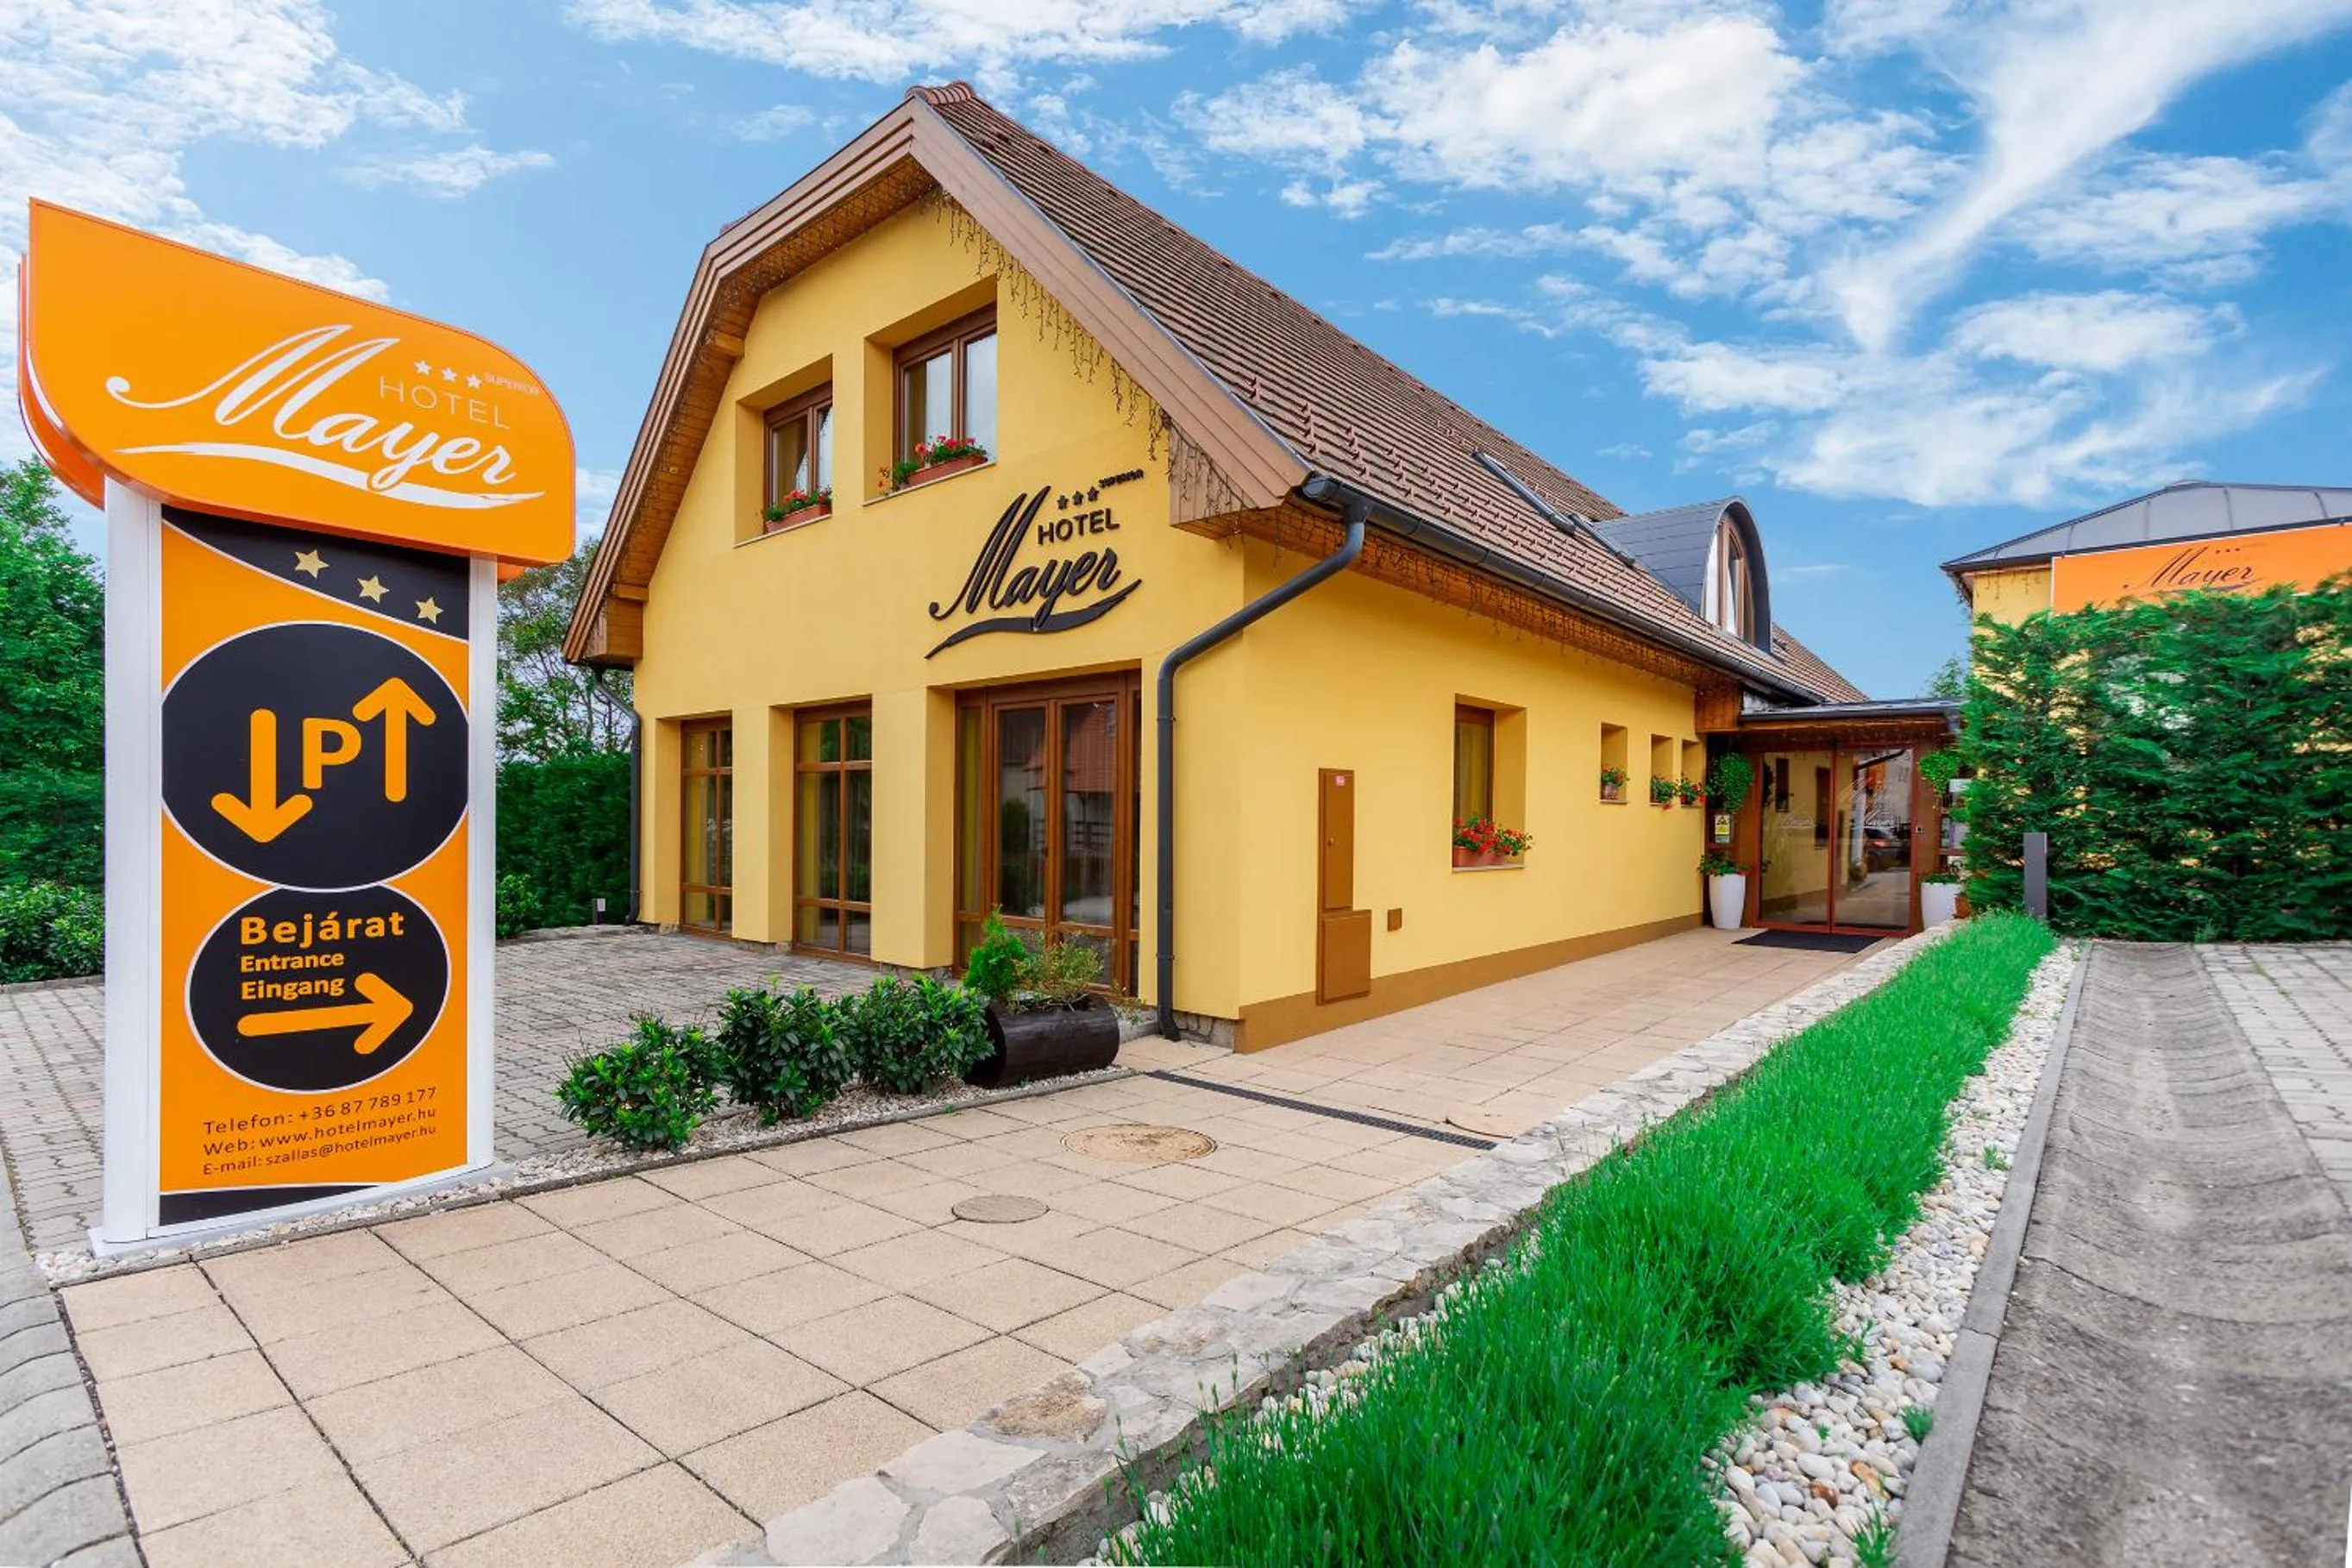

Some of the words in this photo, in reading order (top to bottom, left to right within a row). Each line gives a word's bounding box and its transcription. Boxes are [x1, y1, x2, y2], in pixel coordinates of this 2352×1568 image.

[105, 323, 517, 491] Mayer
[379, 375, 511, 430] HOTEL
[1037, 507, 1120, 546] HOTEL
[928, 485, 1122, 630] Mayer
[2123, 546, 2254, 589] Mayer
[302, 717, 362, 790] P
[240, 911, 405, 949] Bejárat
[240, 951, 345, 973] Entrance
[241, 977, 345, 1000] Eingang
[203, 1113, 293, 1136] Telefon:
[299, 1104, 336, 1121] +36
[340, 1100, 364, 1115] 87
[368, 1093, 402, 1111] 789
[406, 1086, 438, 1103] 177
[203, 1139, 255, 1157] Web:
[260, 1107, 436, 1147] www.hotelmayer.hu
[202, 1154, 262, 1176] E-mail:
[266, 1124, 437, 1166] szallas@hotelmayer.hu
